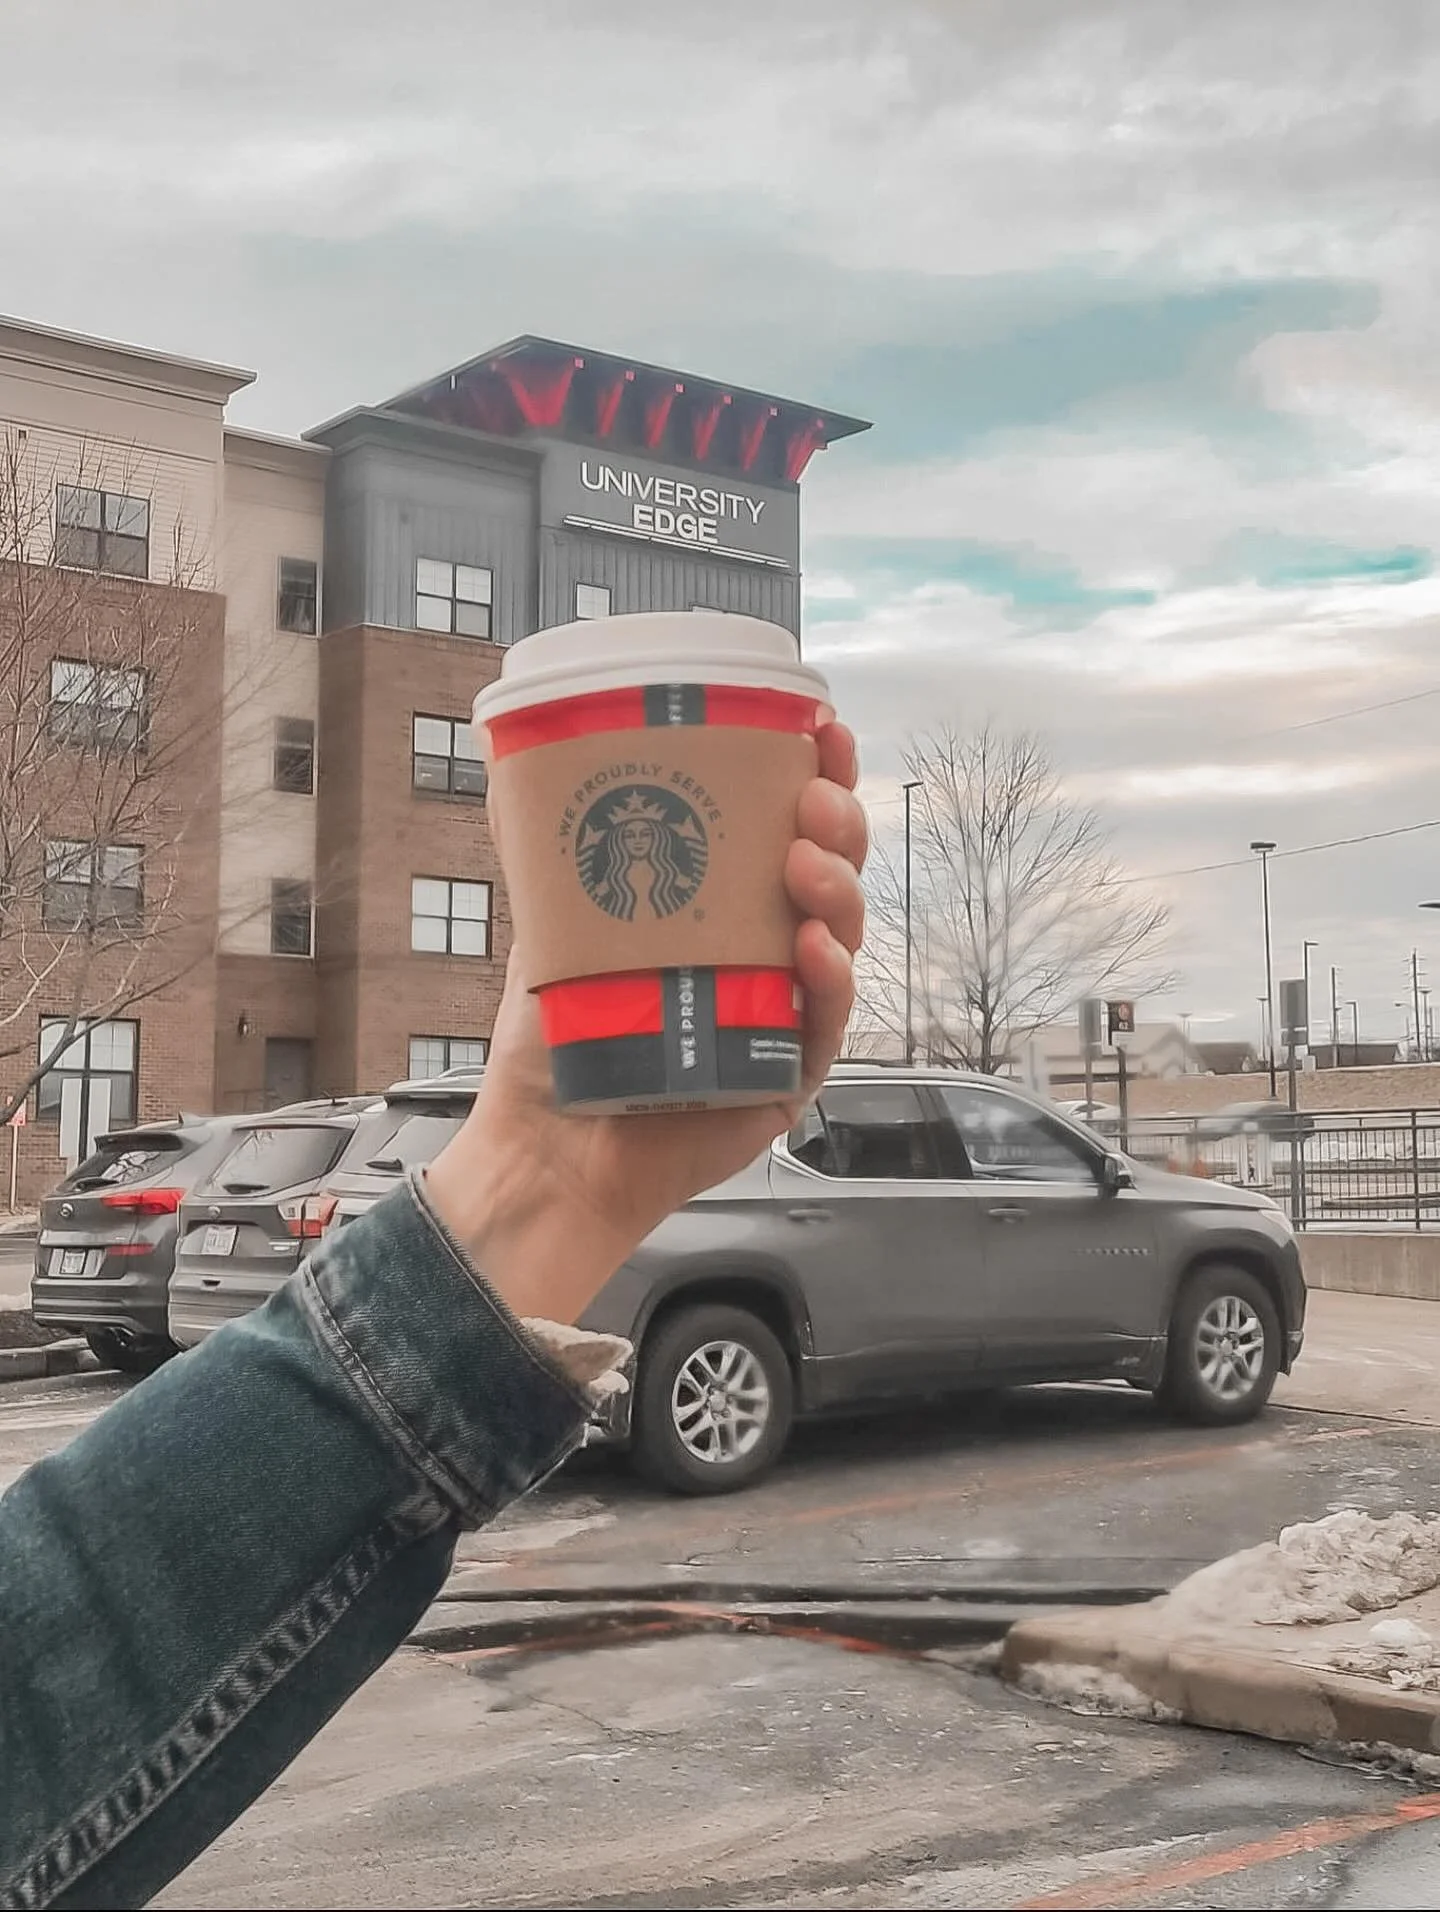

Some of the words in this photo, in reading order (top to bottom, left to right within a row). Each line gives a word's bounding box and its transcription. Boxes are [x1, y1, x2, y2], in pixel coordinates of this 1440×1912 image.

[580, 461, 765, 524] UNIVERSITY
[633, 503, 718, 544] EDGE
[559, 806, 576, 837] WE
[574, 763, 663, 804] PROUDLY
[669, 770, 722, 823] SERVE
[680, 969, 695, 1031] PROU
